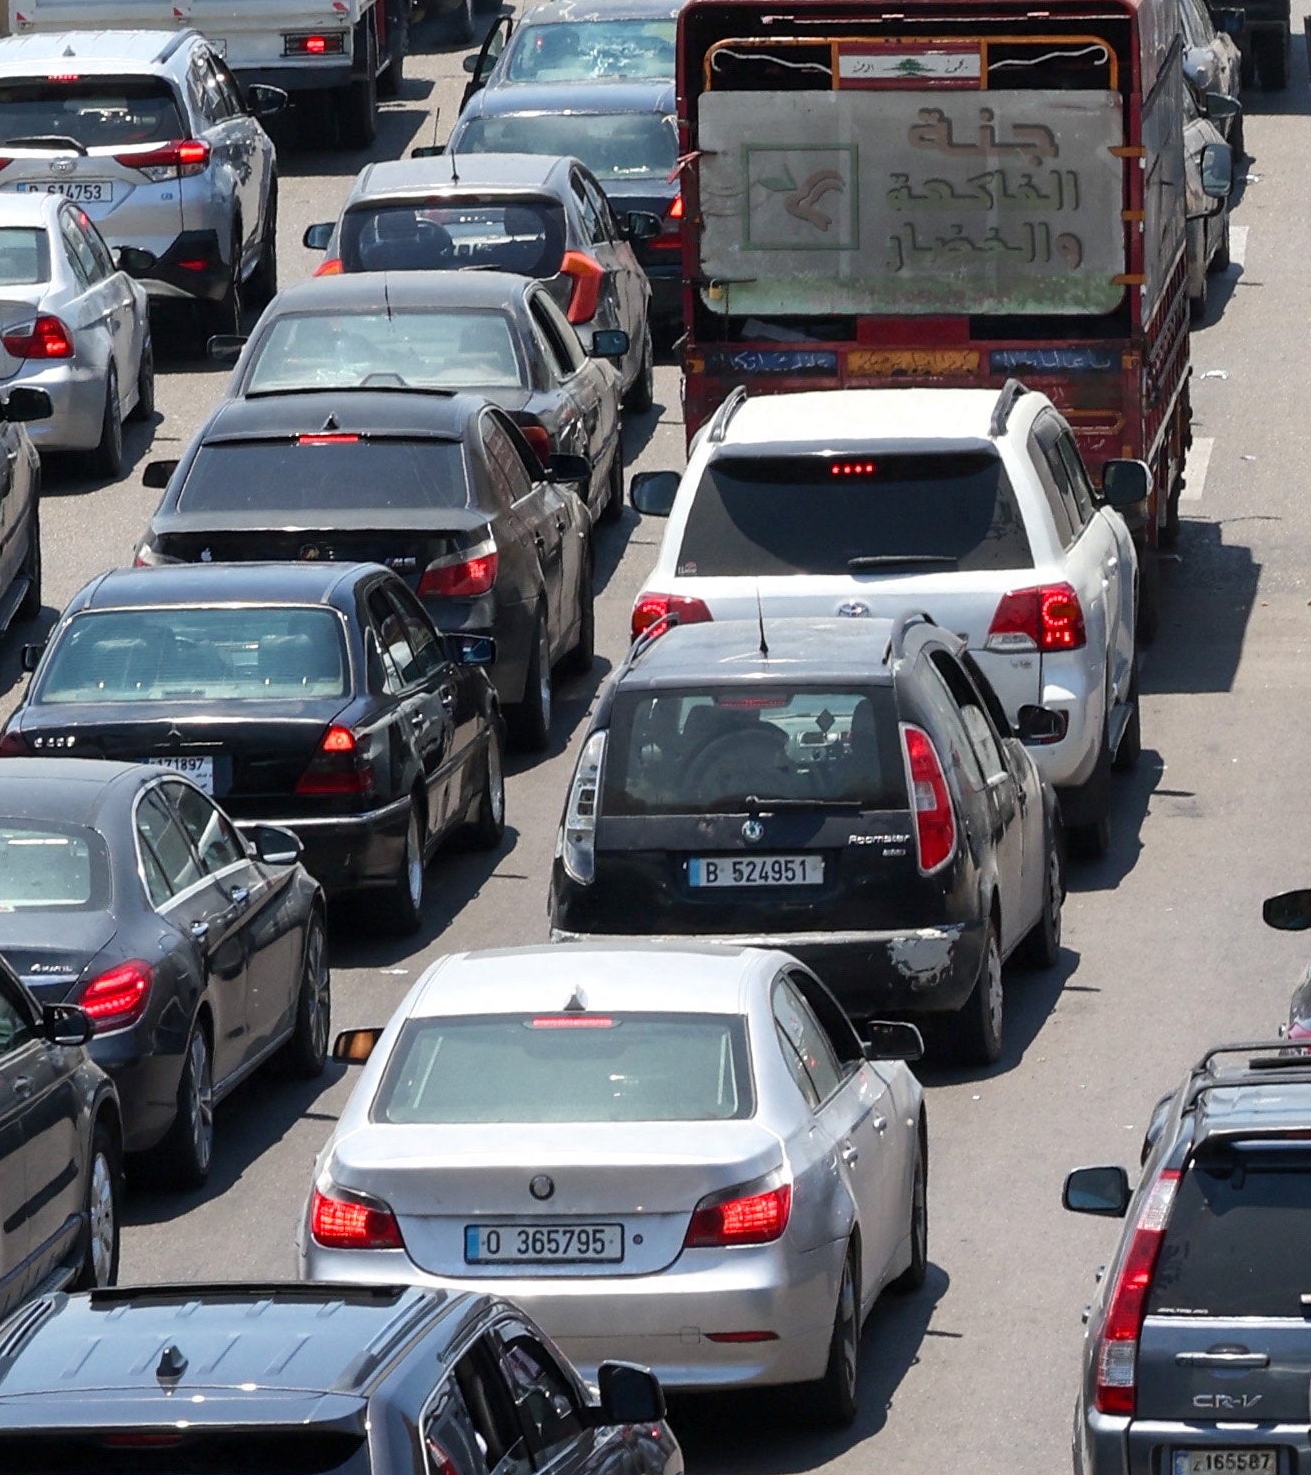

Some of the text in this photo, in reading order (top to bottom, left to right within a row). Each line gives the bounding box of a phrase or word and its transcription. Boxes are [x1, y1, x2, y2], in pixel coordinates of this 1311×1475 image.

[705, 859, 808, 884] B 524951
[517, 1229, 606, 1258] 365795
[1192, 1394, 1263, 1409] CR-V
